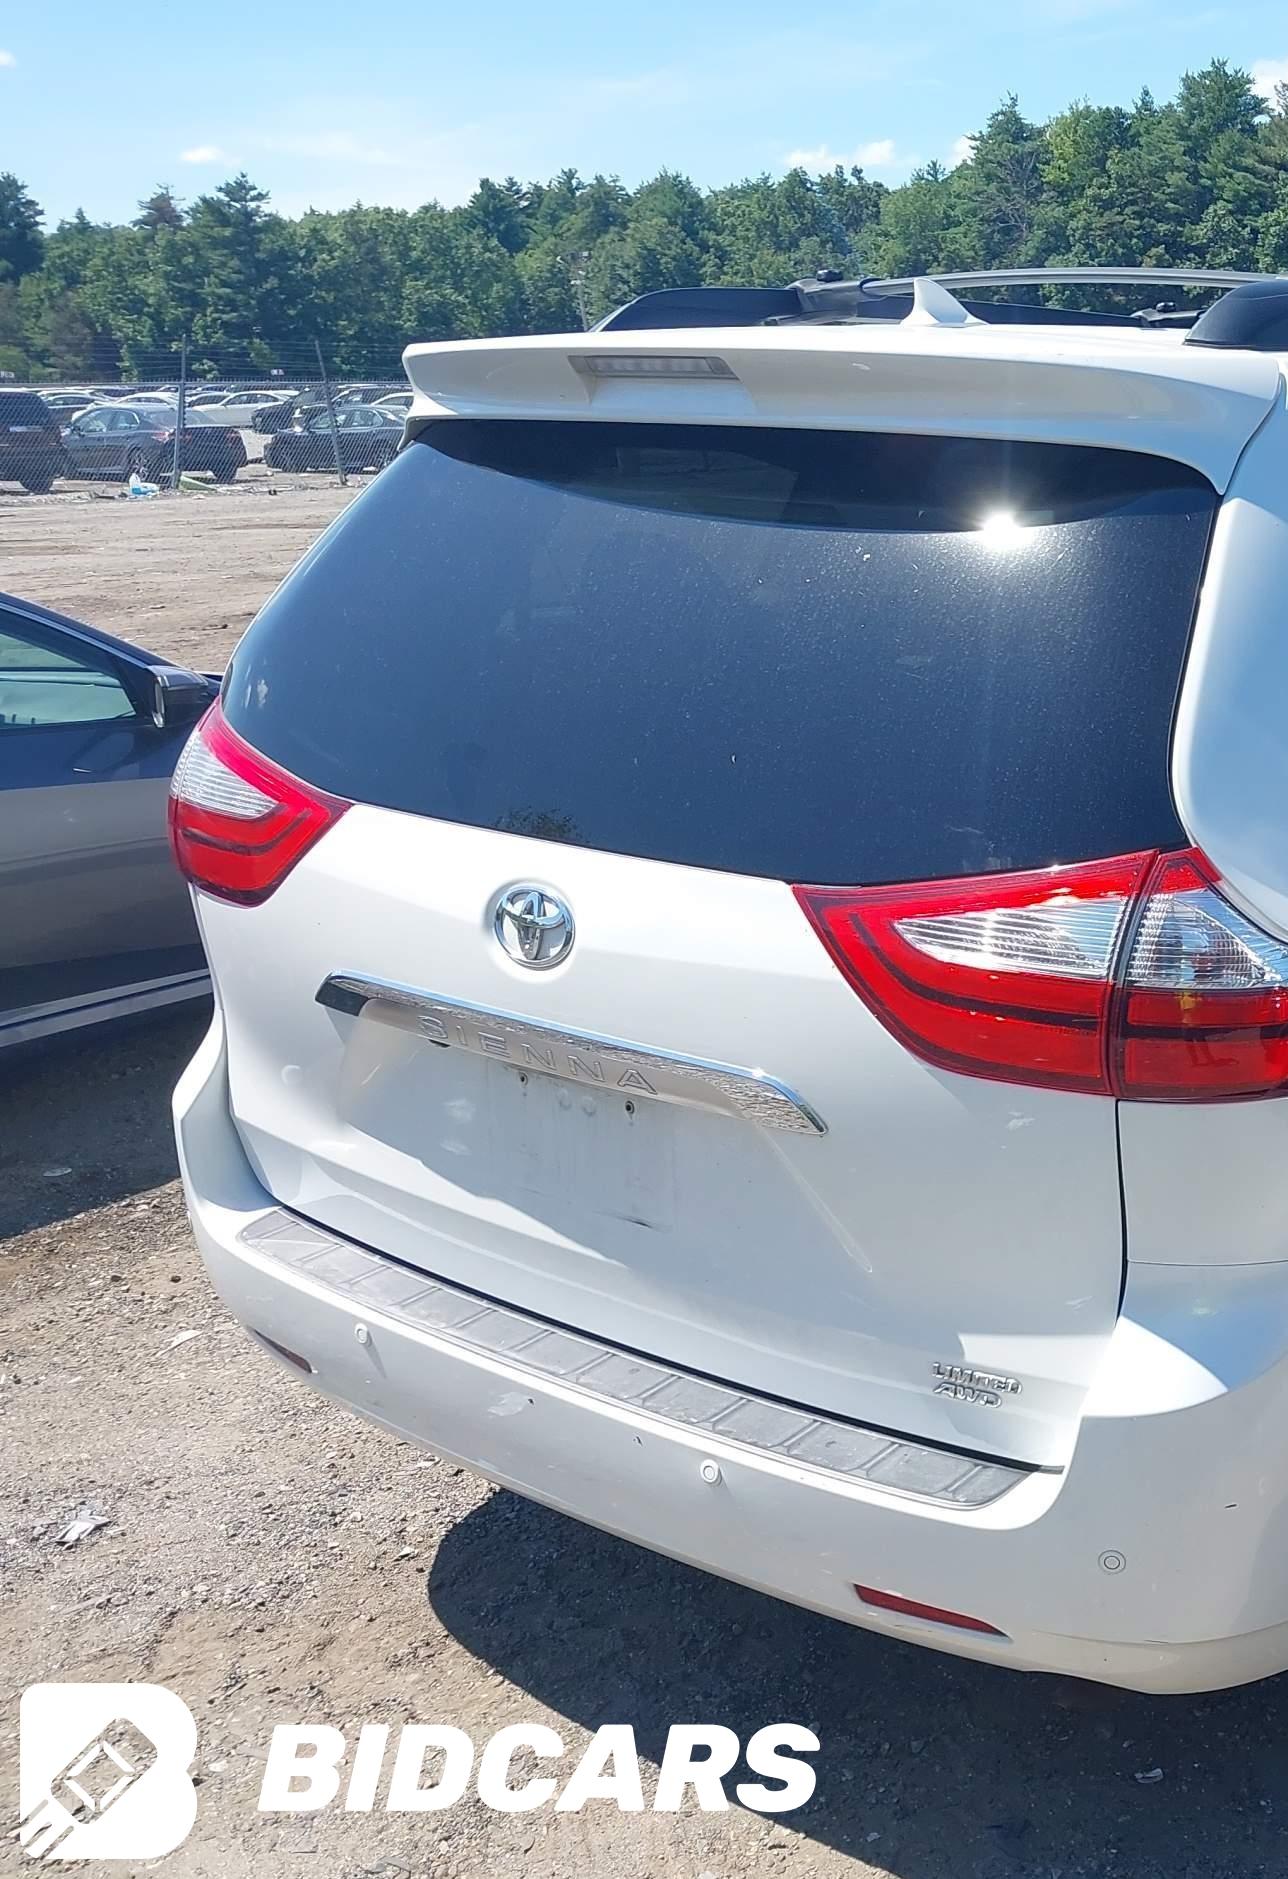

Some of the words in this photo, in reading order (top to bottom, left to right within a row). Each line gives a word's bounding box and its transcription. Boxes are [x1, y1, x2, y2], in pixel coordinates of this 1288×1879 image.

[416, 1014, 658, 1096] SIENNA
[932, 1362, 1022, 1394] LIMITED
[934, 1382, 1002, 1408] AWD
